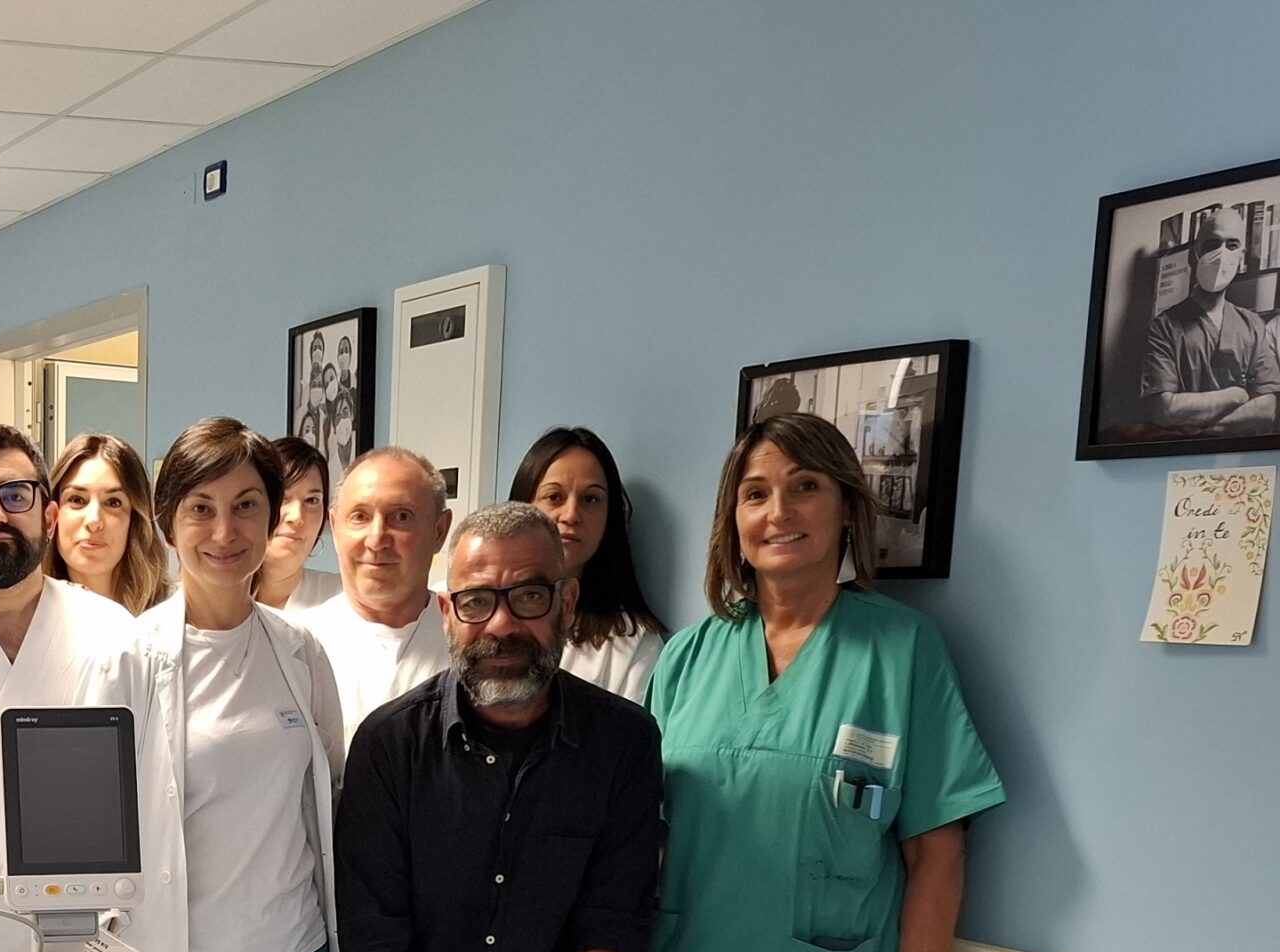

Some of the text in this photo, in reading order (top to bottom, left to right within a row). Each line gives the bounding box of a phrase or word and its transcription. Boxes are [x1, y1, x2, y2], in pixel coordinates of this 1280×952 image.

[1174, 494, 1221, 517] Credi
[1184, 521, 1230, 539] in te
[15, 716, 39, 724] mindray
